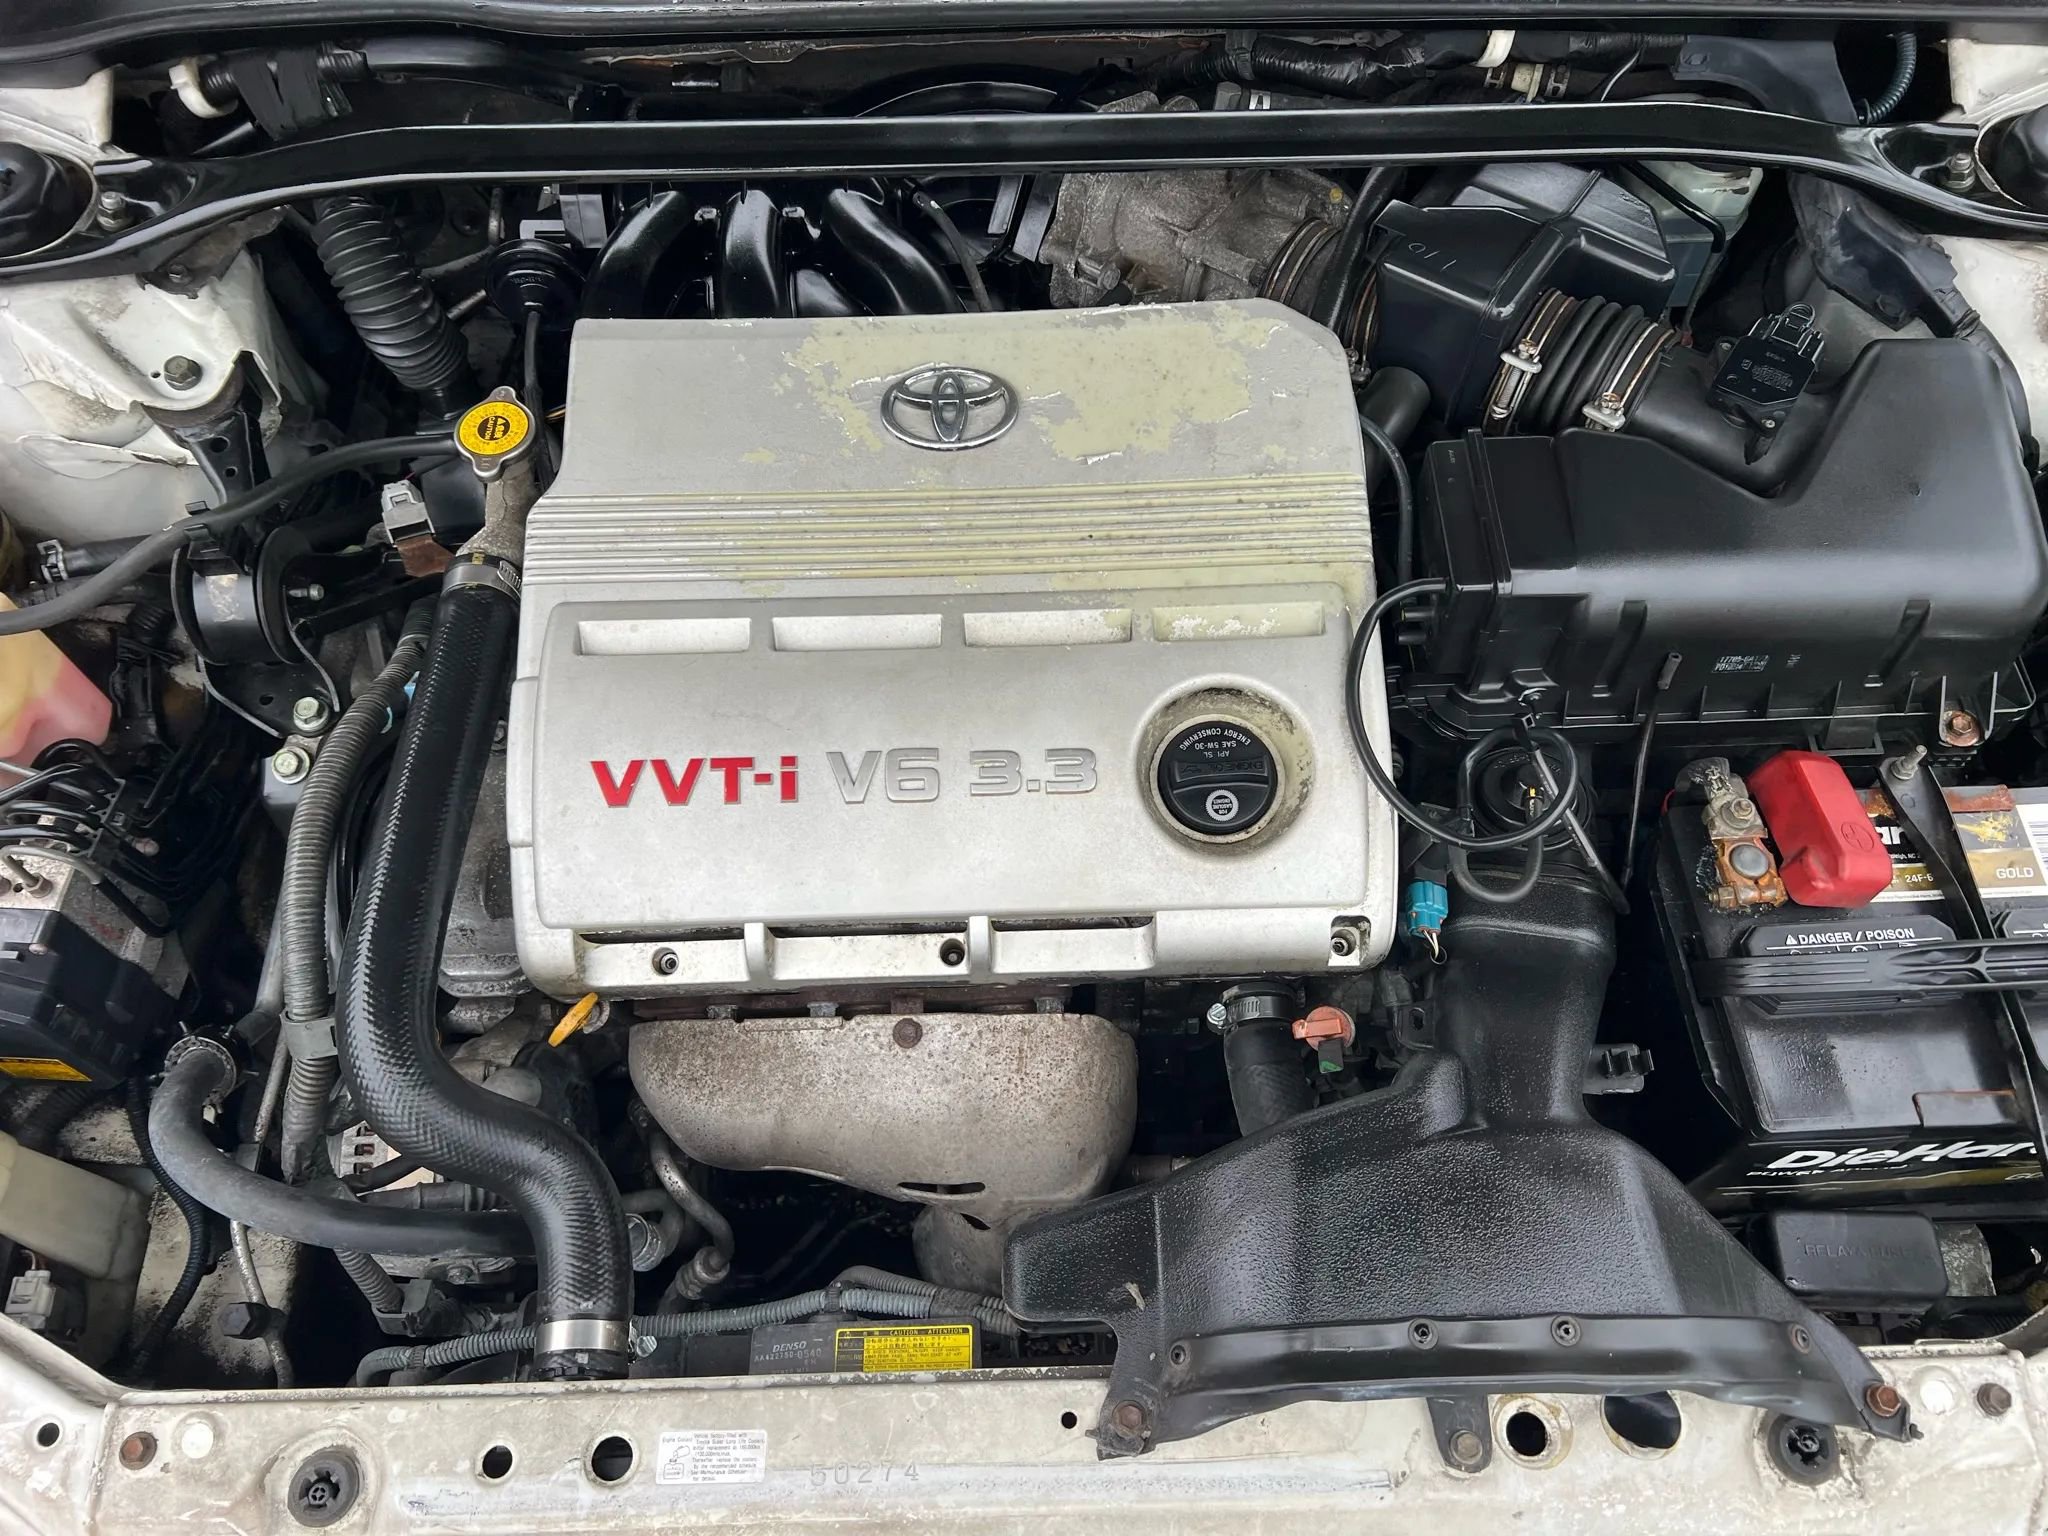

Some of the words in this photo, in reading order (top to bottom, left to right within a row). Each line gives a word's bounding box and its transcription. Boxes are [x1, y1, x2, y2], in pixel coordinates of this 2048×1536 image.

[485, 417, 495, 439] CAUTION
[1179, 728, 1221, 750] CONSERVING
[1222, 740, 1237, 748] SAE
[1223, 728, 1251, 746] ENERGY
[1195, 741, 1219, 750] 5W-30
[1217, 750, 1230, 758] API
[590, 755, 799, 808] VVT-i
[826, 748, 940, 804] V6
[969, 747, 1098, 797] 3.3
[1996, 867, 2035, 879] GOLD
[1798, 932, 1852, 945] DANGER
[1867, 927, 1916, 940] POISON
[1767, 1140, 2037, 1169] DieHar
[1804, 1244, 1854, 1257] RELAY
[927, 1327, 963, 1335] ATTENTION
[772, 1341, 807, 1353] DENSO
[809, 1459, 920, 1487] 50274
